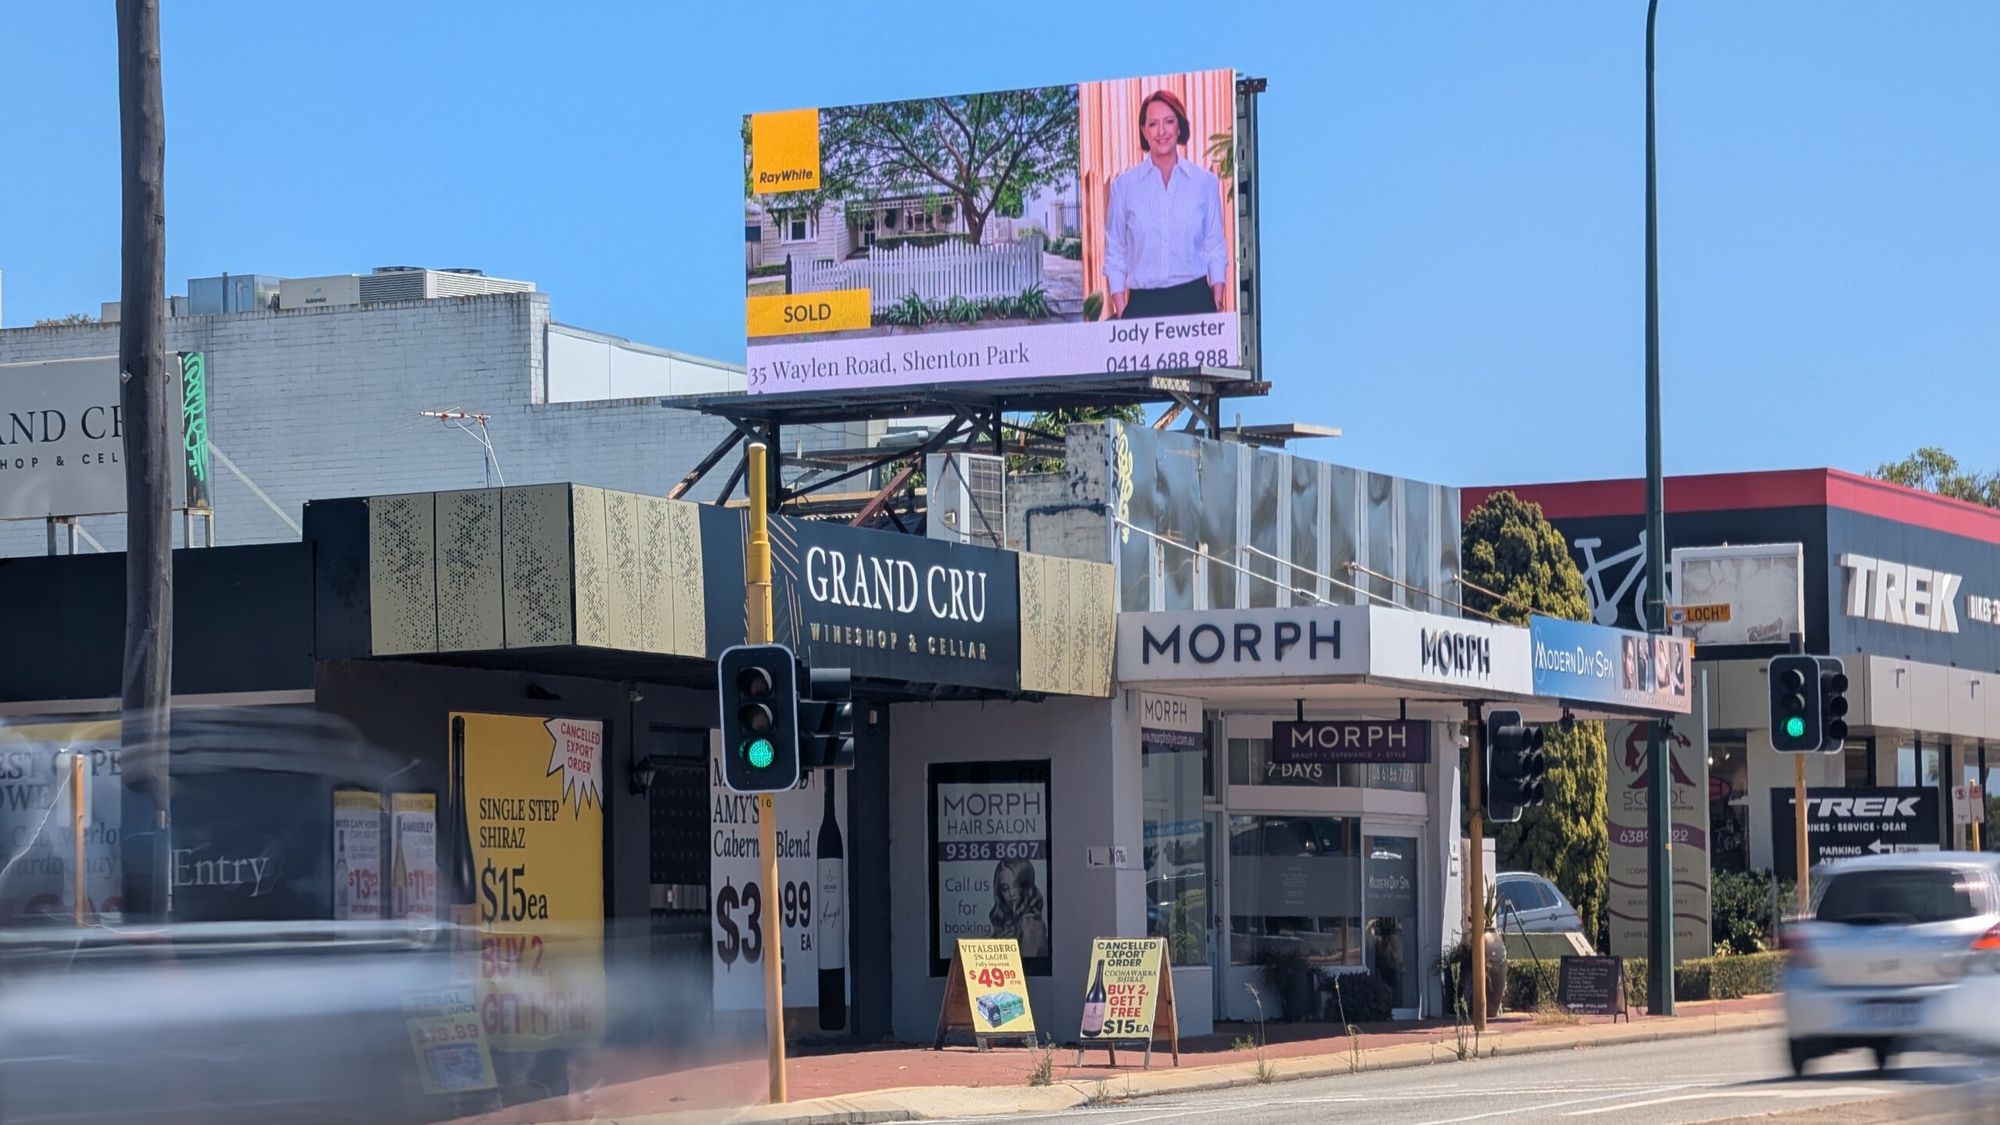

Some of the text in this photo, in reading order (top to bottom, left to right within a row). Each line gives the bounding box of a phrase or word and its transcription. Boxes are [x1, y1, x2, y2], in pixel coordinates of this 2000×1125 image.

[783, 303, 831, 324] SOLD
[1109, 320, 1225, 345] Jody Fewster
[750, 343, 1030, 386] 35 Waylen Road, Shenton Park
[1106, 348, 1228, 373] 0414 688 988
[56, 455, 64, 467] &
[82, 452, 118, 465] CEL
[807, 546, 987, 623] GRAND CRU
[1841, 553, 1963, 634] TREK
[1688, 607, 1719, 621] LOCH
[810, 622, 987, 660] WINESHOP & CELLAR
[1142, 619, 1341, 665] MORPH
[1421, 627, 1491, 681] MORPH
[1144, 698, 1188, 724] MORPH
[560, 721, 601, 746] CANCELLED
[1291, 726, 1406, 748] MORPH
[566, 739, 594, 760] EXPORT
[567, 756, 591, 775] ORDER
[1281, 763, 1323, 778] DAYS
[479, 797, 560, 822] SINGLE STEP
[713, 794, 760, 824] AMY'S
[944, 792, 1041, 817] MORPH
[1788, 797, 1921, 817] TREK
[947, 818, 1037, 835] HAIR SALON
[1837, 822, 1875, 832] SERVICE
[1882, 822, 1907, 832] GEAR
[479, 826, 526, 849] SHIRAZ
[713, 829, 811, 859] Cabern Blend
[946, 842, 1040, 859] 9386 8607
[1819, 845, 1862, 855] PARKING
[171, 848, 271, 897] Entry
[945, 877, 990, 892] Call us
[958, 900, 978, 916] for
[944, 921, 992, 936] booking
[801, 933, 812, 951] EA
[961, 944, 1018, 953] VITALSBERG
[1097, 942, 1157, 950] CANCELLED
[1106, 950, 1146, 958] EXPORT
[1107, 959, 1142, 967] ORDER
[1107, 984, 1149, 996] BUY 2,
[1109, 996, 1143, 1006] GET 1
[1110, 1007, 1142, 1018] FREE
